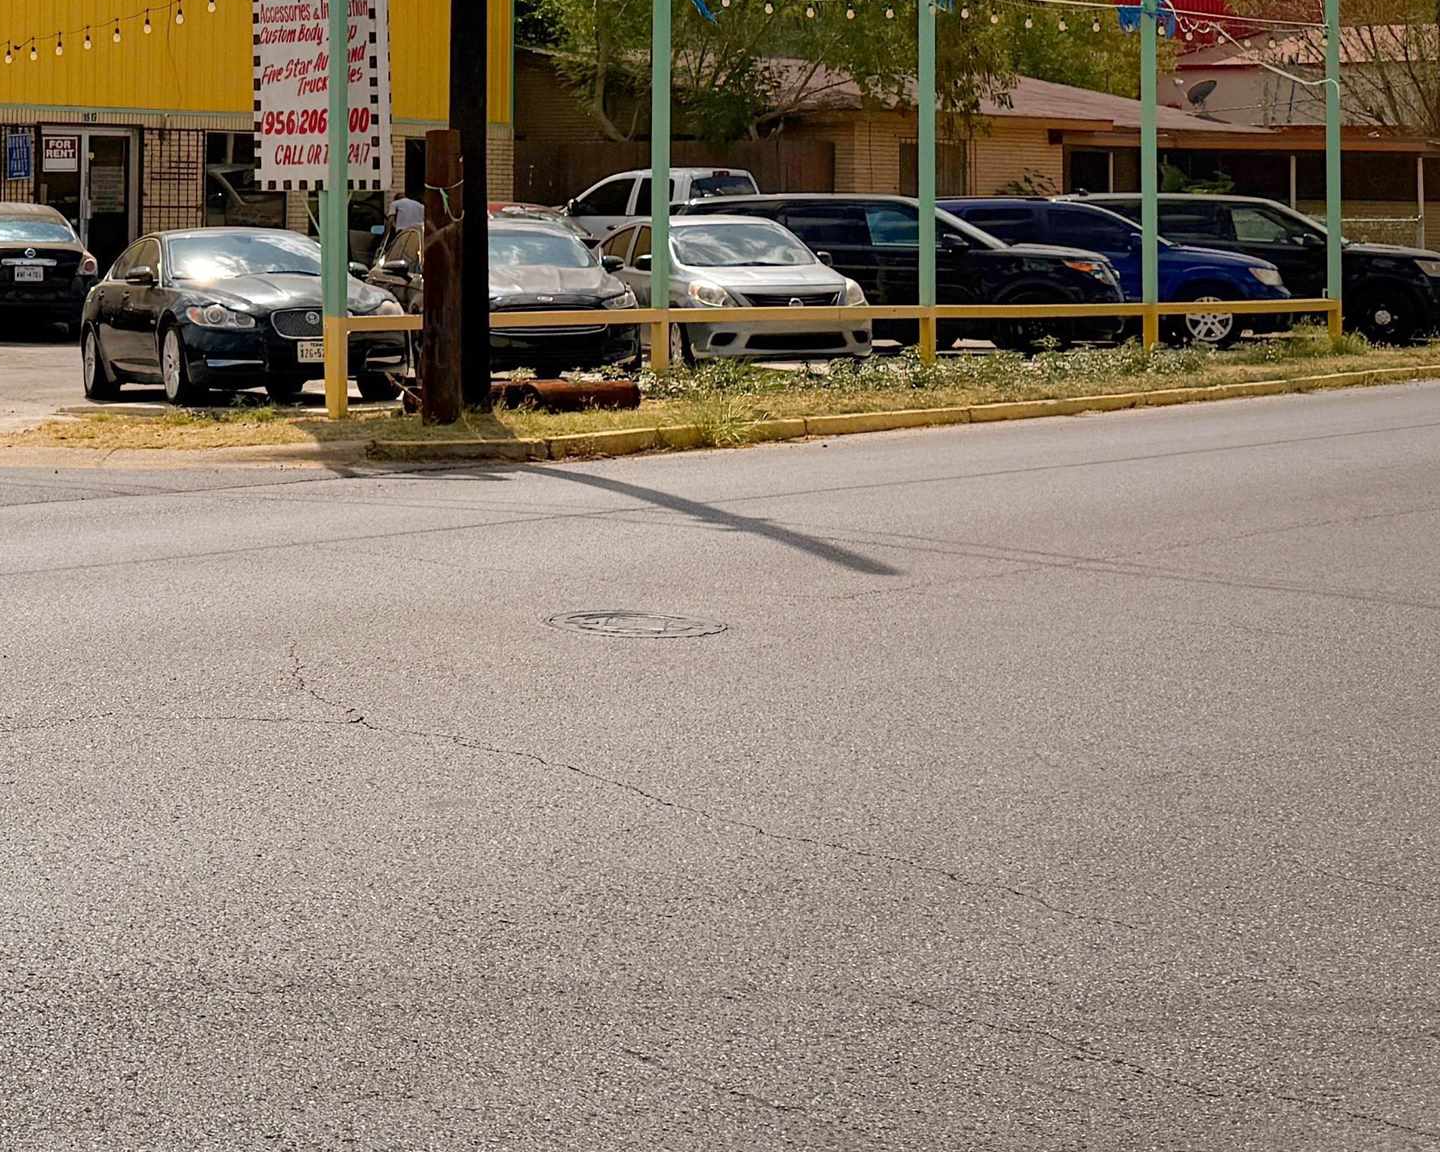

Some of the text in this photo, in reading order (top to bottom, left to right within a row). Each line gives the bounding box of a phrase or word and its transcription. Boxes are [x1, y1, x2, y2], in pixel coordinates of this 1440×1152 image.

[260, 0, 310, 23] Accessories
[259, 24, 296, 44] Custom
[297, 23, 323, 46] Body
[261, 64, 283, 86] Five
[285, 57, 313, 79] Star
[46, 149, 74, 158] RENT
[49, 140, 71, 149] FOR
[275, 144, 304, 166] CALL
[307, 143, 322, 164] OR
